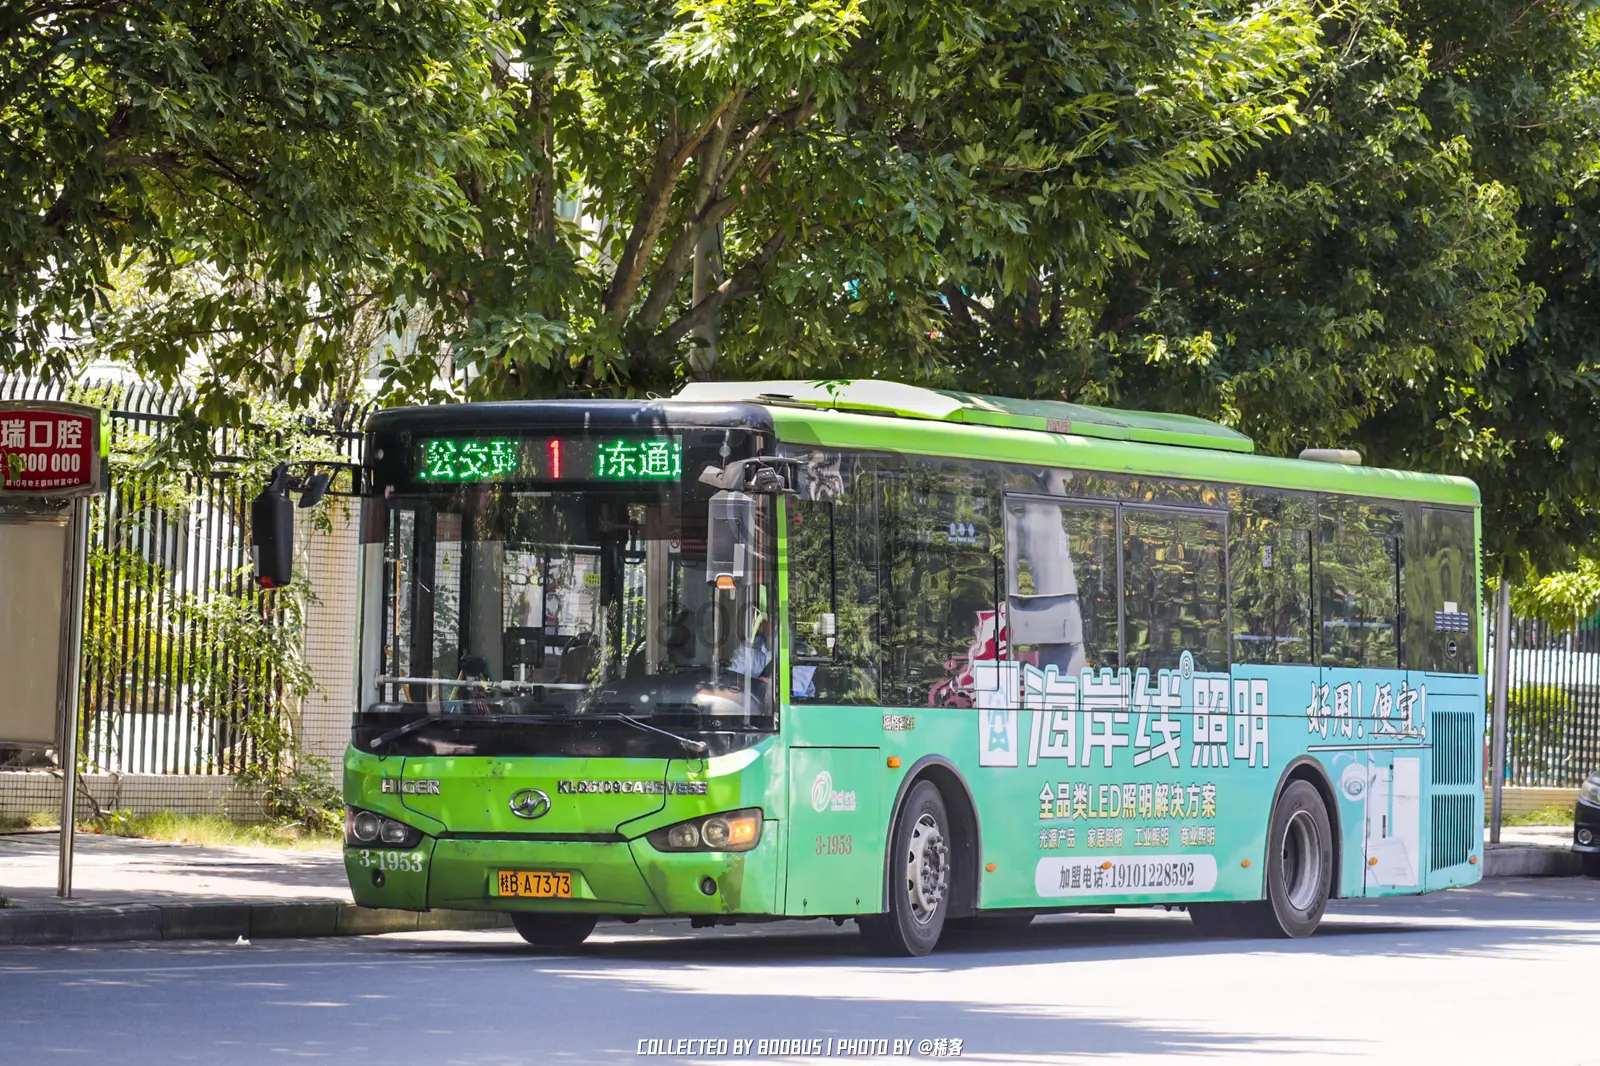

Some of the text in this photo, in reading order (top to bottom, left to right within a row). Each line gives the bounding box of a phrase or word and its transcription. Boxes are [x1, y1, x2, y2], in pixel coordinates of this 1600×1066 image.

[550, 440, 559, 478] 1
[381, 779, 440, 794] HIGER
[1038, 781, 1217, 820] 全品类LED照明解决方案
[815, 835, 853, 855] 3-1953
[1087, 827, 1123, 848] 家居照明
[1133, 827, 1170, 847] 工业照明
[1180, 826, 1216, 847] 商业照明
[359, 849, 423, 872] 3-1953
